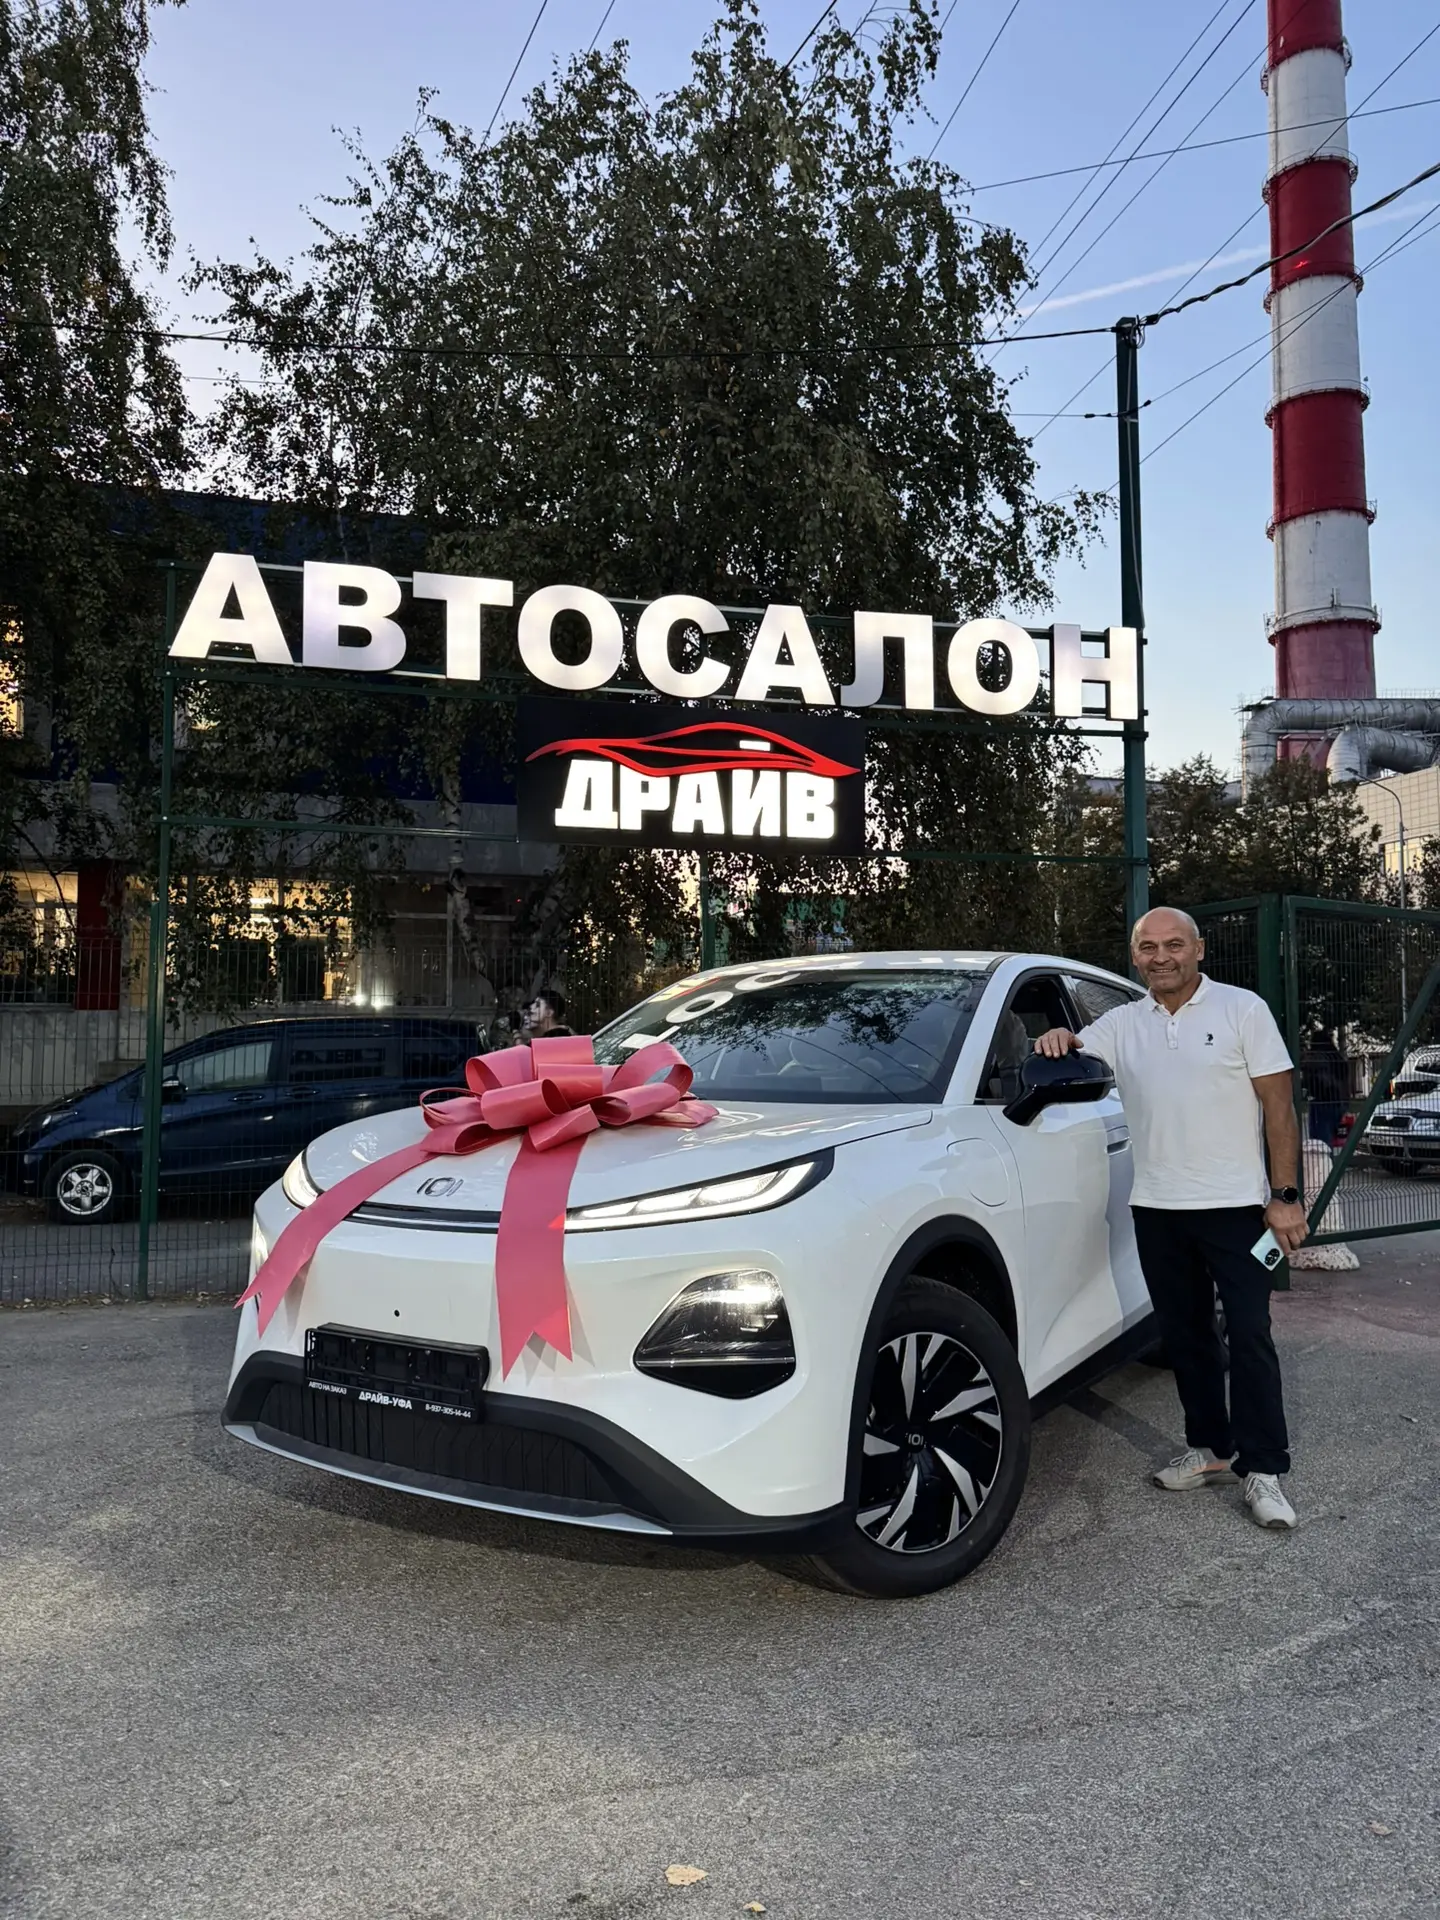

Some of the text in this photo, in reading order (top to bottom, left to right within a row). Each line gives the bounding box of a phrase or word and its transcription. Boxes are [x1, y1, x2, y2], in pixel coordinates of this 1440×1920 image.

[168, 552, 1140, 720] АВТОСАЛОН
[555, 740, 834, 839] ДРАЙВ
[358, 1391, 412, 1410] ДРАЙВ-УФА
